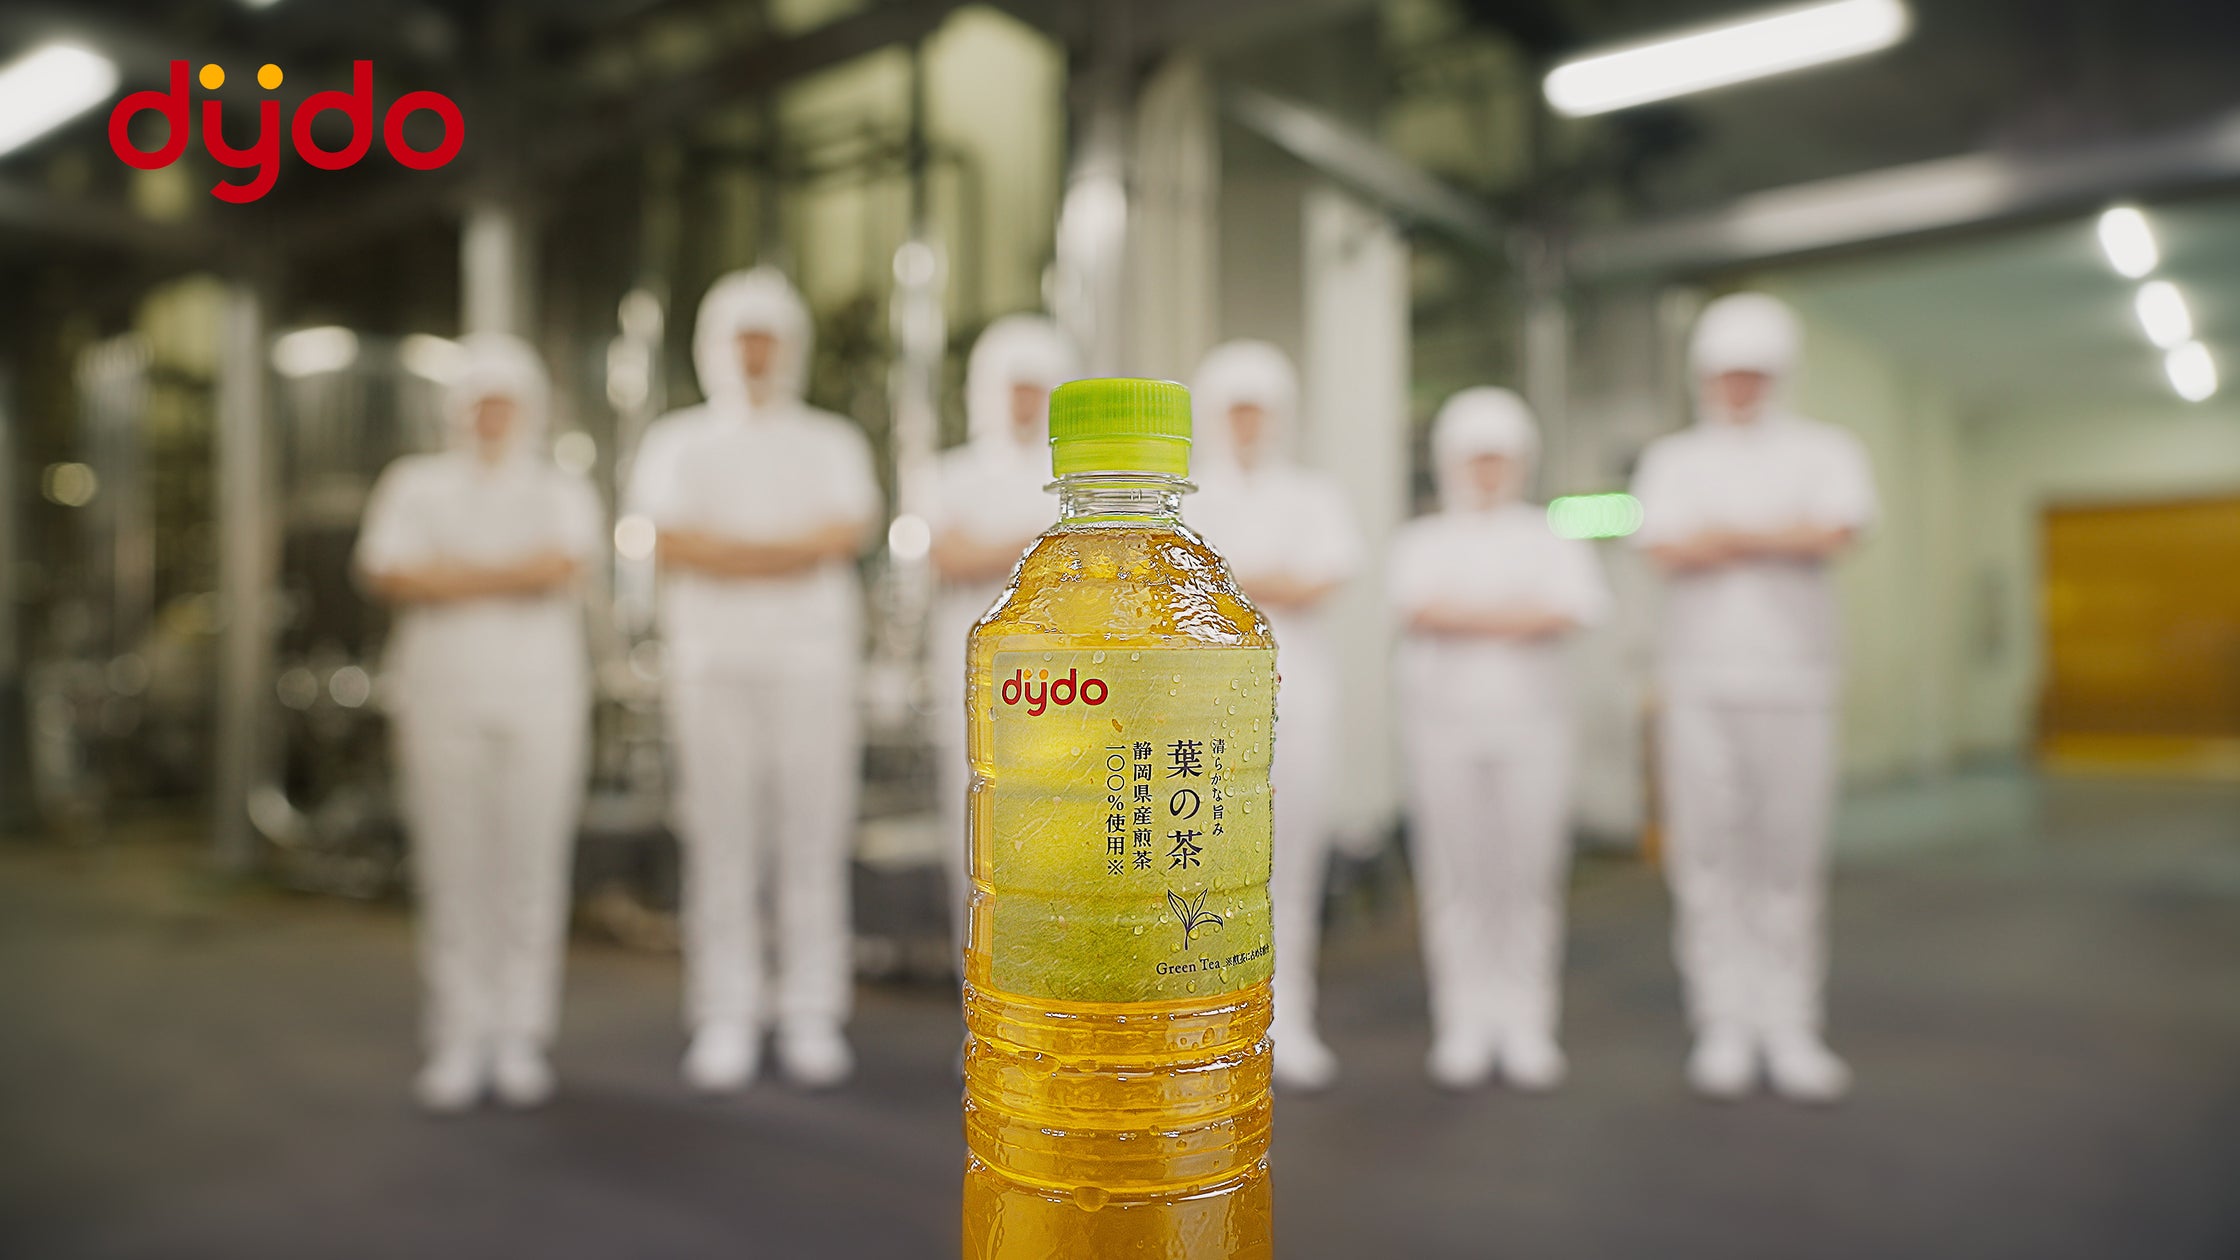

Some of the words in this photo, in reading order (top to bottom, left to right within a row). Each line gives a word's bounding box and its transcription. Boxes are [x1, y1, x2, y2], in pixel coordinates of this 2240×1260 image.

[1132, 741, 1152, 870] 静岡県産煎茶
[1166, 739, 1203, 870] 葉の茶
[1211, 738, 1225, 836] 清らかな旨み
[1156, 962, 1196, 975] Green
[1199, 958, 1220, 971] Tea
